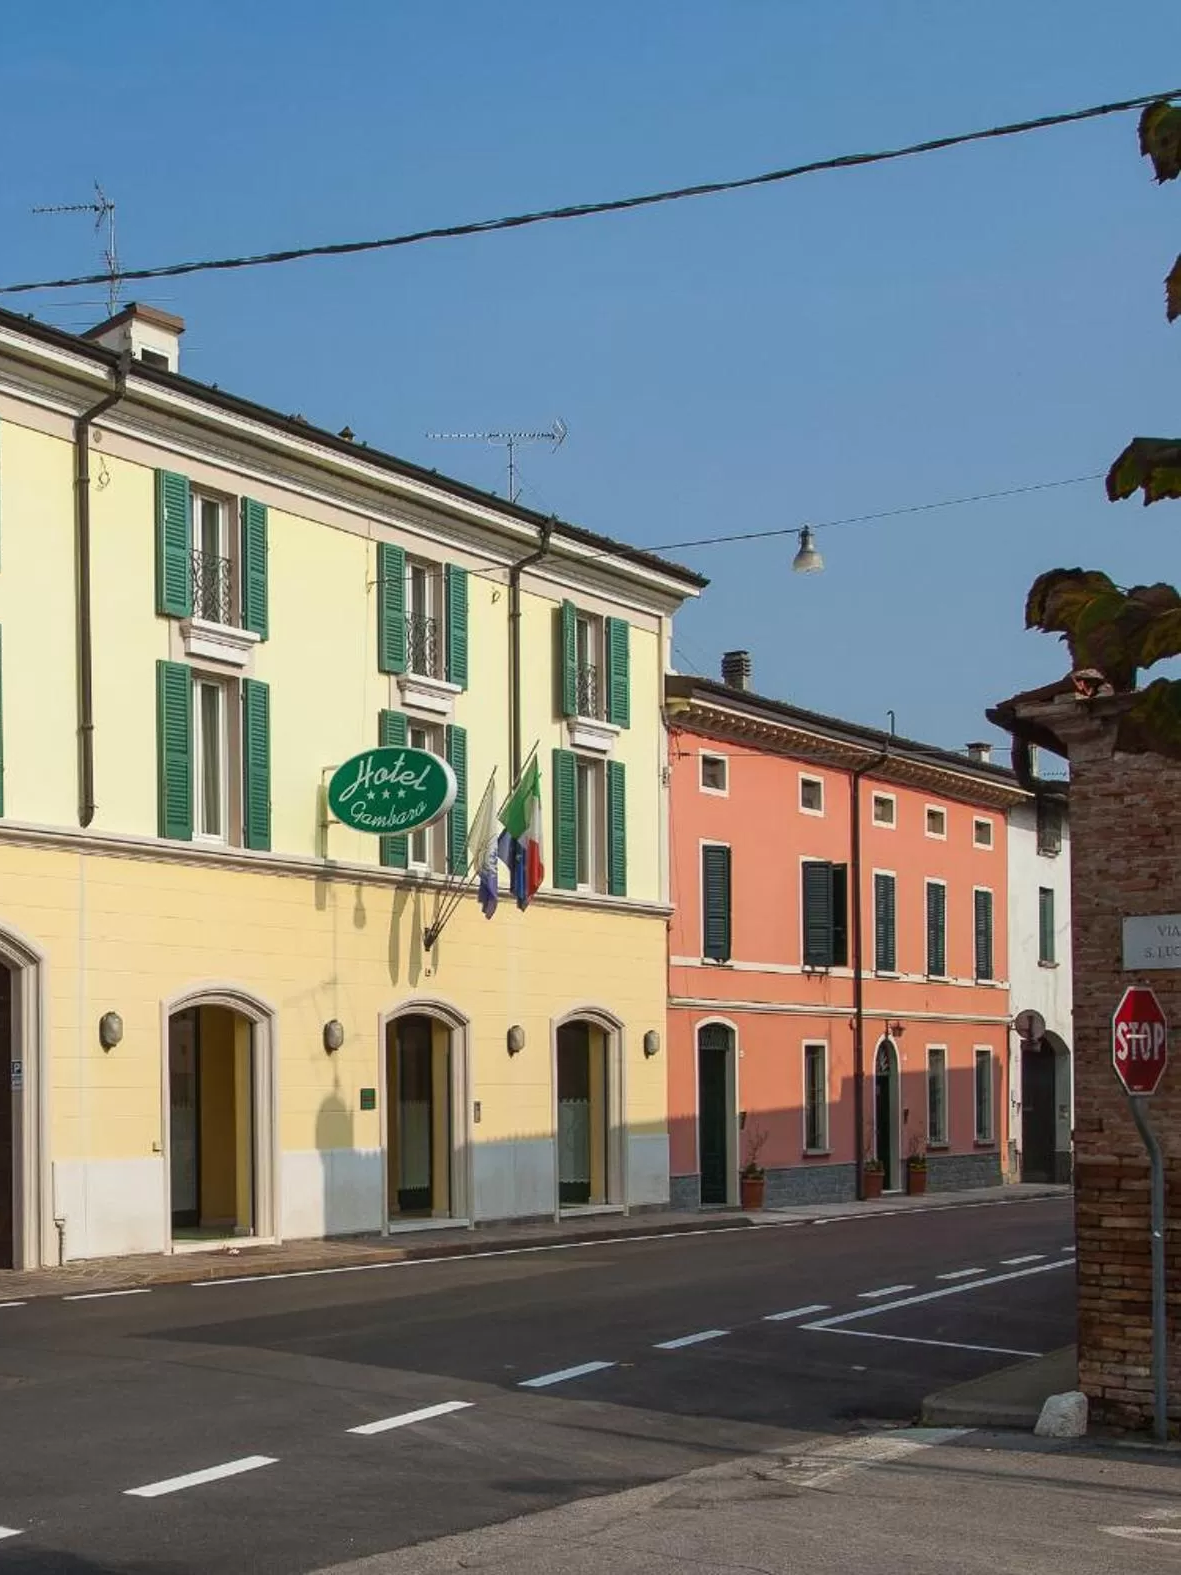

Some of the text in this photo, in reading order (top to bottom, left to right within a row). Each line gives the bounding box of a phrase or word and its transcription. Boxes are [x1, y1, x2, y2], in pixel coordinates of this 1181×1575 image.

[339, 753, 431, 802] Hotel
[1156, 924, 1181, 937] VIA
[1116, 1021, 1164, 1061] STOP
